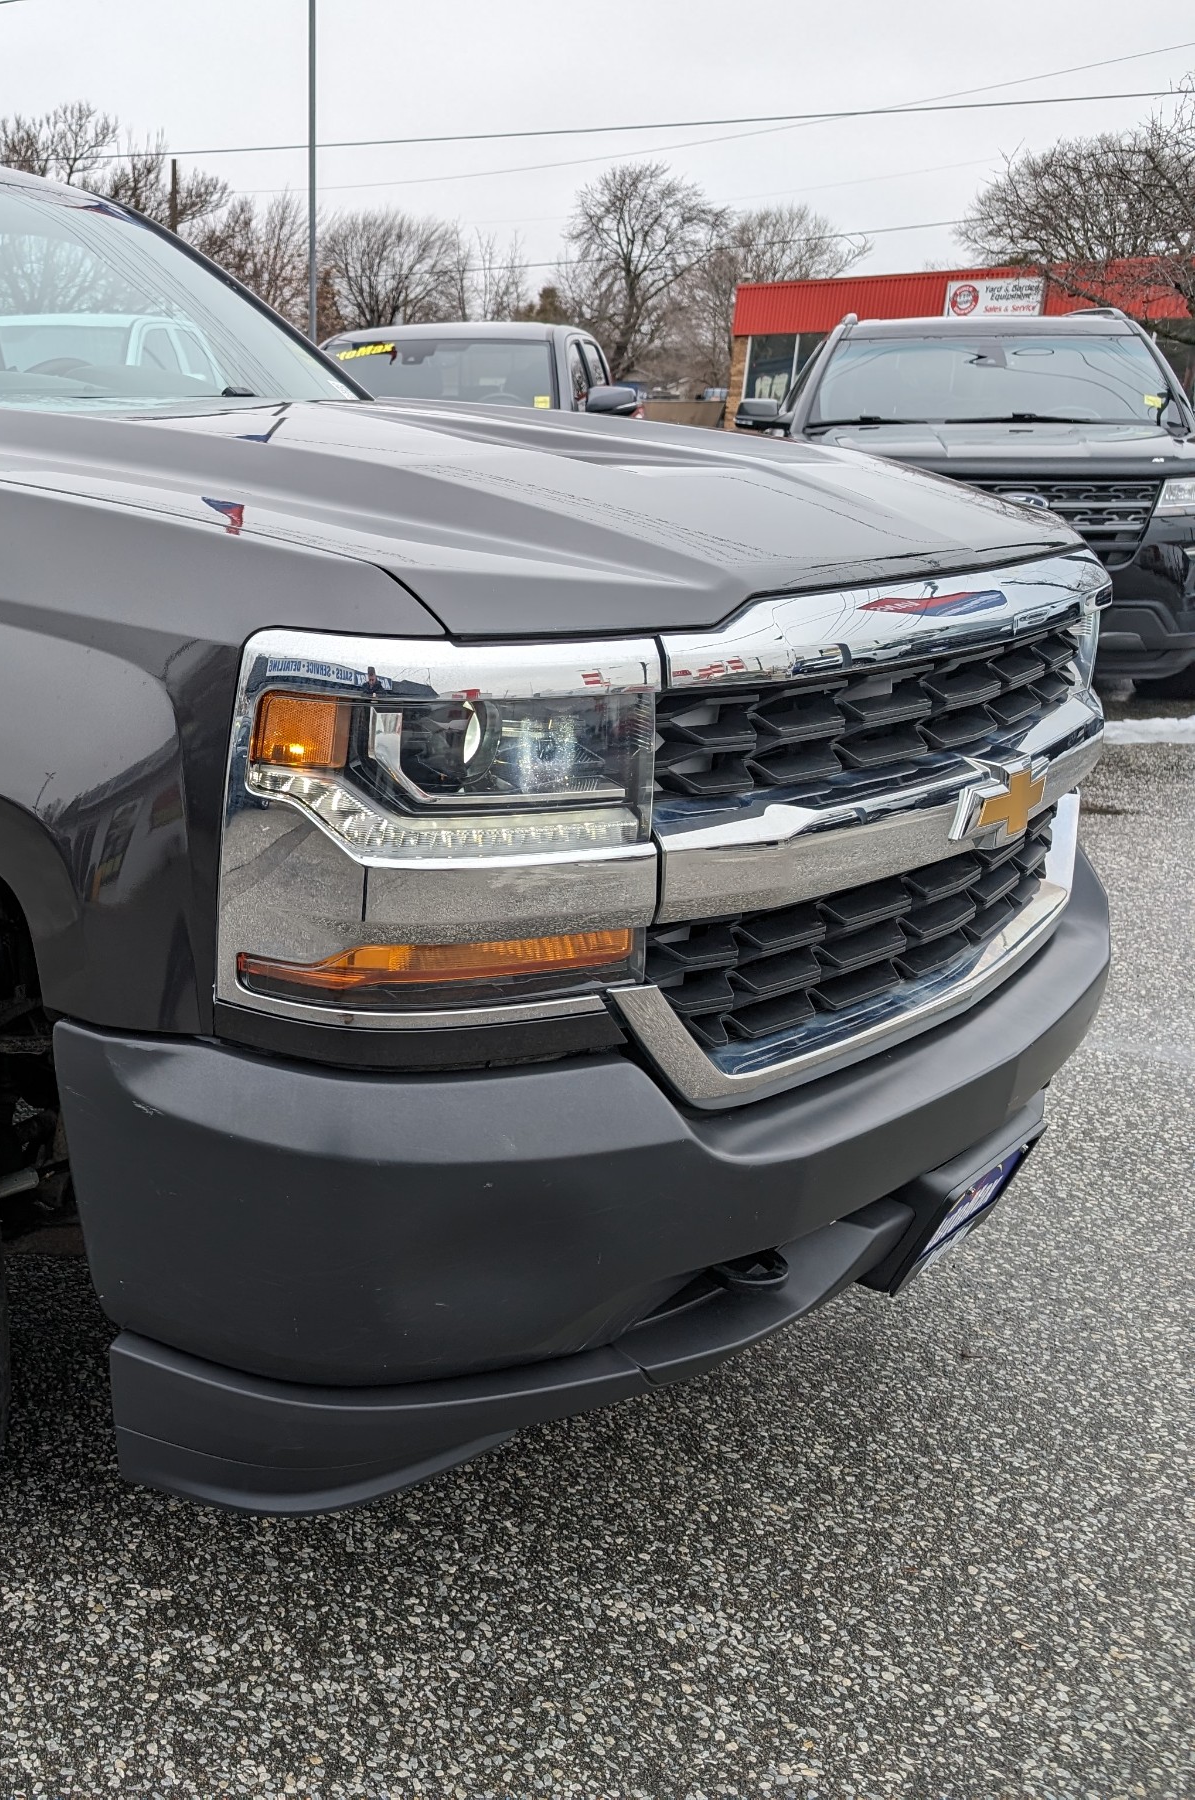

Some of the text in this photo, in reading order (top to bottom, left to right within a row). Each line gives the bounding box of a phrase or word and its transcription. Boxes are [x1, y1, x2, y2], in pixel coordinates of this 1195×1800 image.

[985, 285, 1002, 293] Yard
[983, 305, 1002, 313] Sales
[1011, 304, 1037, 313] Service
